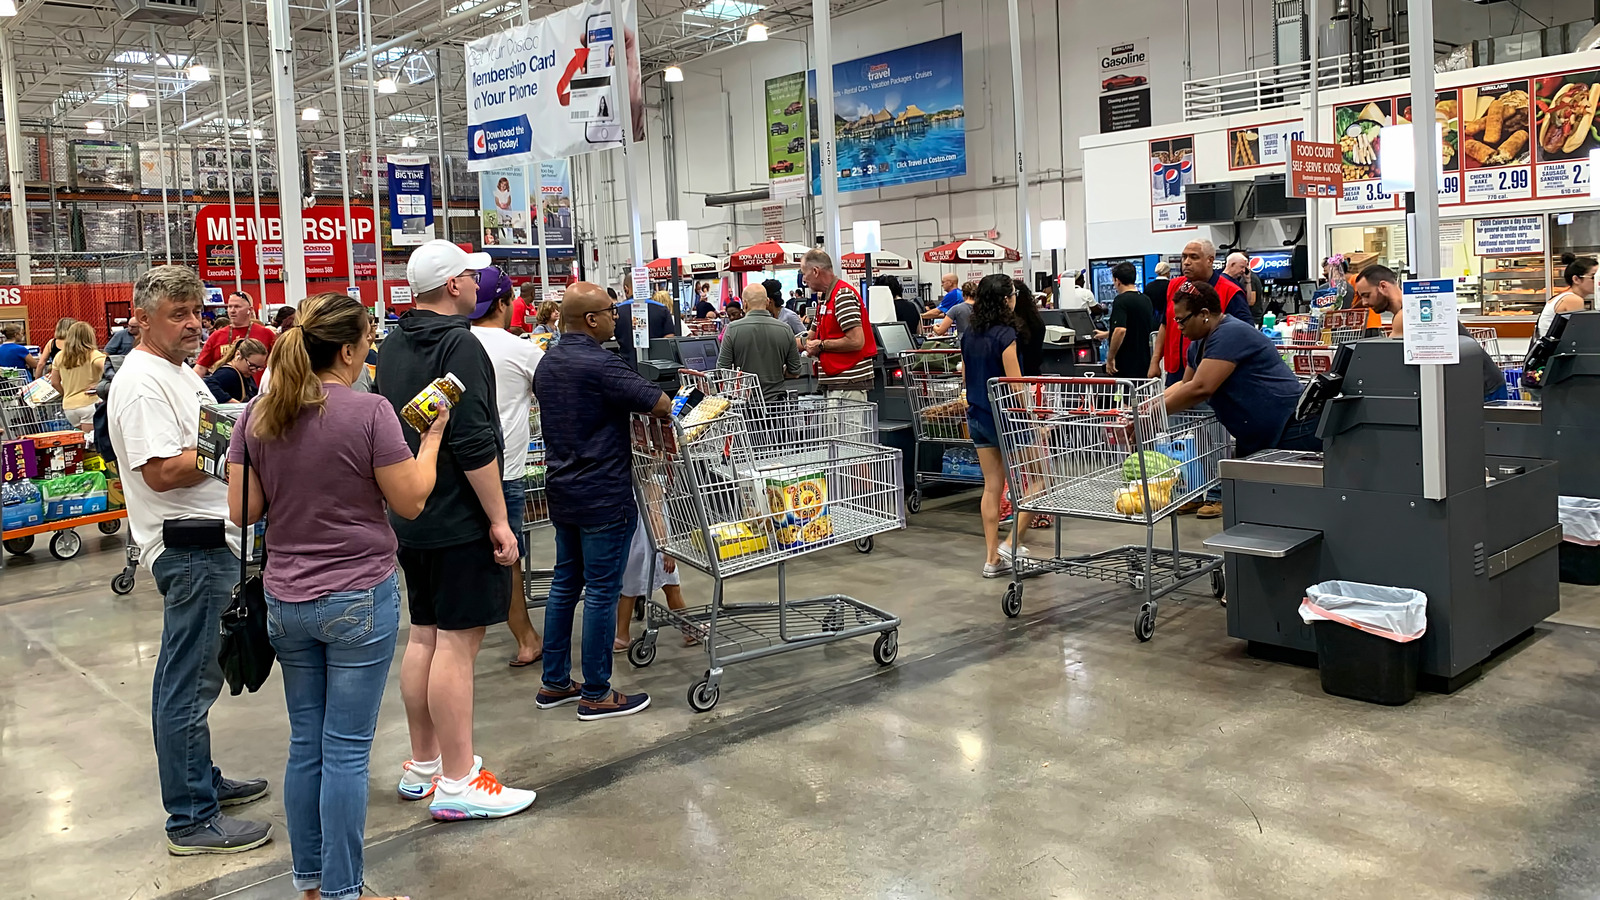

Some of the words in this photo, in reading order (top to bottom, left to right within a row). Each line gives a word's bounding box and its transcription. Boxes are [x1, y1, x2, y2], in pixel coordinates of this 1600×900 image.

[486, 44, 505, 62] Your
[1101, 52, 1146, 69] Gasoline
[473, 59, 527, 88] Membership
[529, 50, 556, 73] Card
[867, 68, 890, 81] travel
[844, 88, 857, 96] Rental
[871, 80, 890, 90] Vacation
[890, 75, 913, 85] Packages
[914, 70, 933, 79] Cruises
[1481, 83, 1508, 92] KIRKLAND
[481, 90, 506, 109] Your
[509, 82, 538, 103] Phone
[486, 128, 515, 141] Download
[516, 125, 525, 137] the
[487, 142, 499, 154] App
[498, 137, 520, 151] Today!
[1297, 145, 1313, 157] FOOD
[1314, 146, 1335, 158] COURT
[897, 160, 908, 170] Click
[908, 158, 923, 168] Travel
[929, 154, 957, 165] Costco.com
[1323, 162, 1342, 174] KIOSK
[395, 171, 407, 179] BIG
[409, 172, 424, 180] TIME
[1498, 169, 1528, 191] 2.99
[1437, 176, 1458, 194] .99
[1178, 205, 1187, 221] .5
[1527, 216, 1538, 224] used
[207, 217, 372, 241] MEMBRSHIP
[1478, 239, 1497, 247] Additional
[1264, 258, 1290, 269] pepsi
[207, 269, 229, 277] Executive
[1316, 295, 1338, 306] RUFFL
